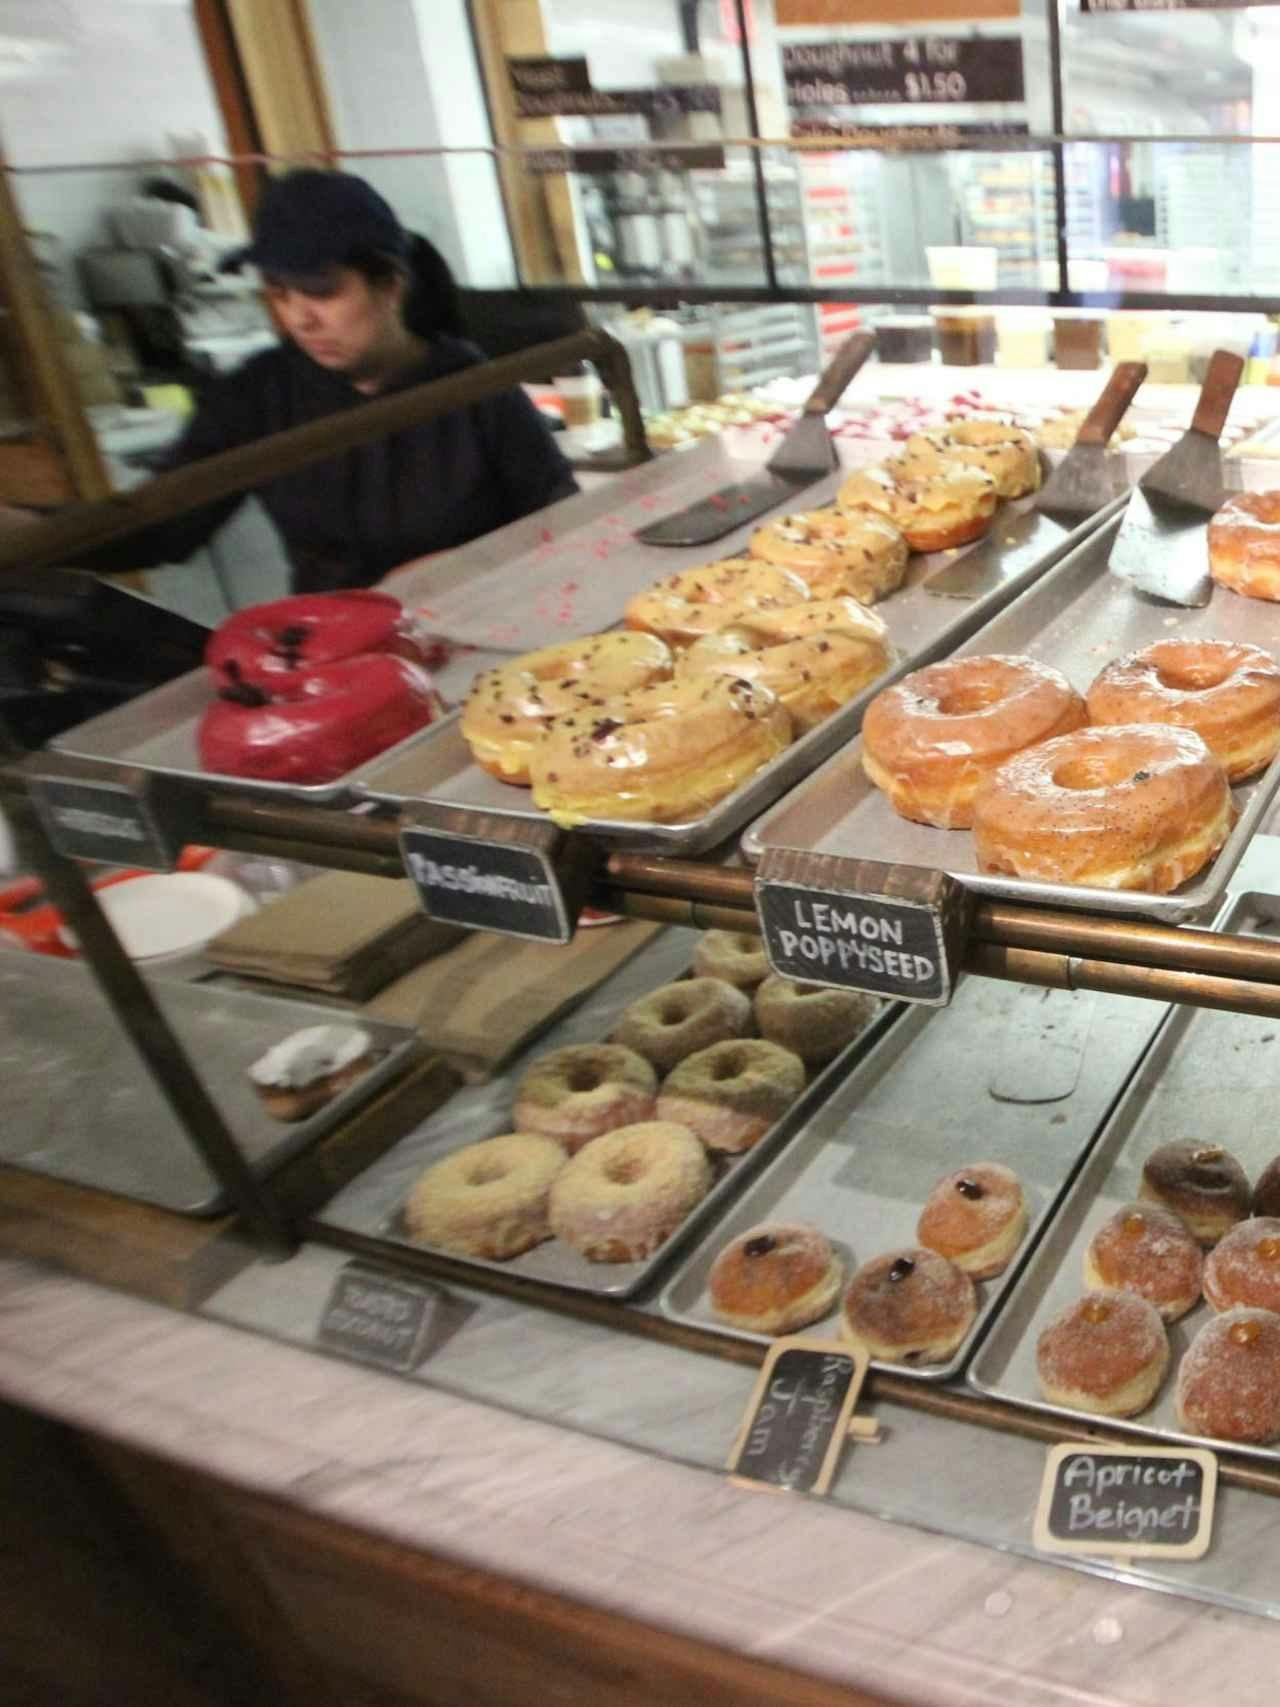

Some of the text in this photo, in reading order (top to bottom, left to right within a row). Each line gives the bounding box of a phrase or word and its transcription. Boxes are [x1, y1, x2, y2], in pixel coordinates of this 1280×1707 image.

[903, 70, 968, 101] $1.50
[794, 900, 903, 945] LEMON
[778, 930, 935, 982] POPPYSEED
[1063, 1455, 1196, 1496] Apricot
[1069, 1492, 1200, 1539] Beignet
